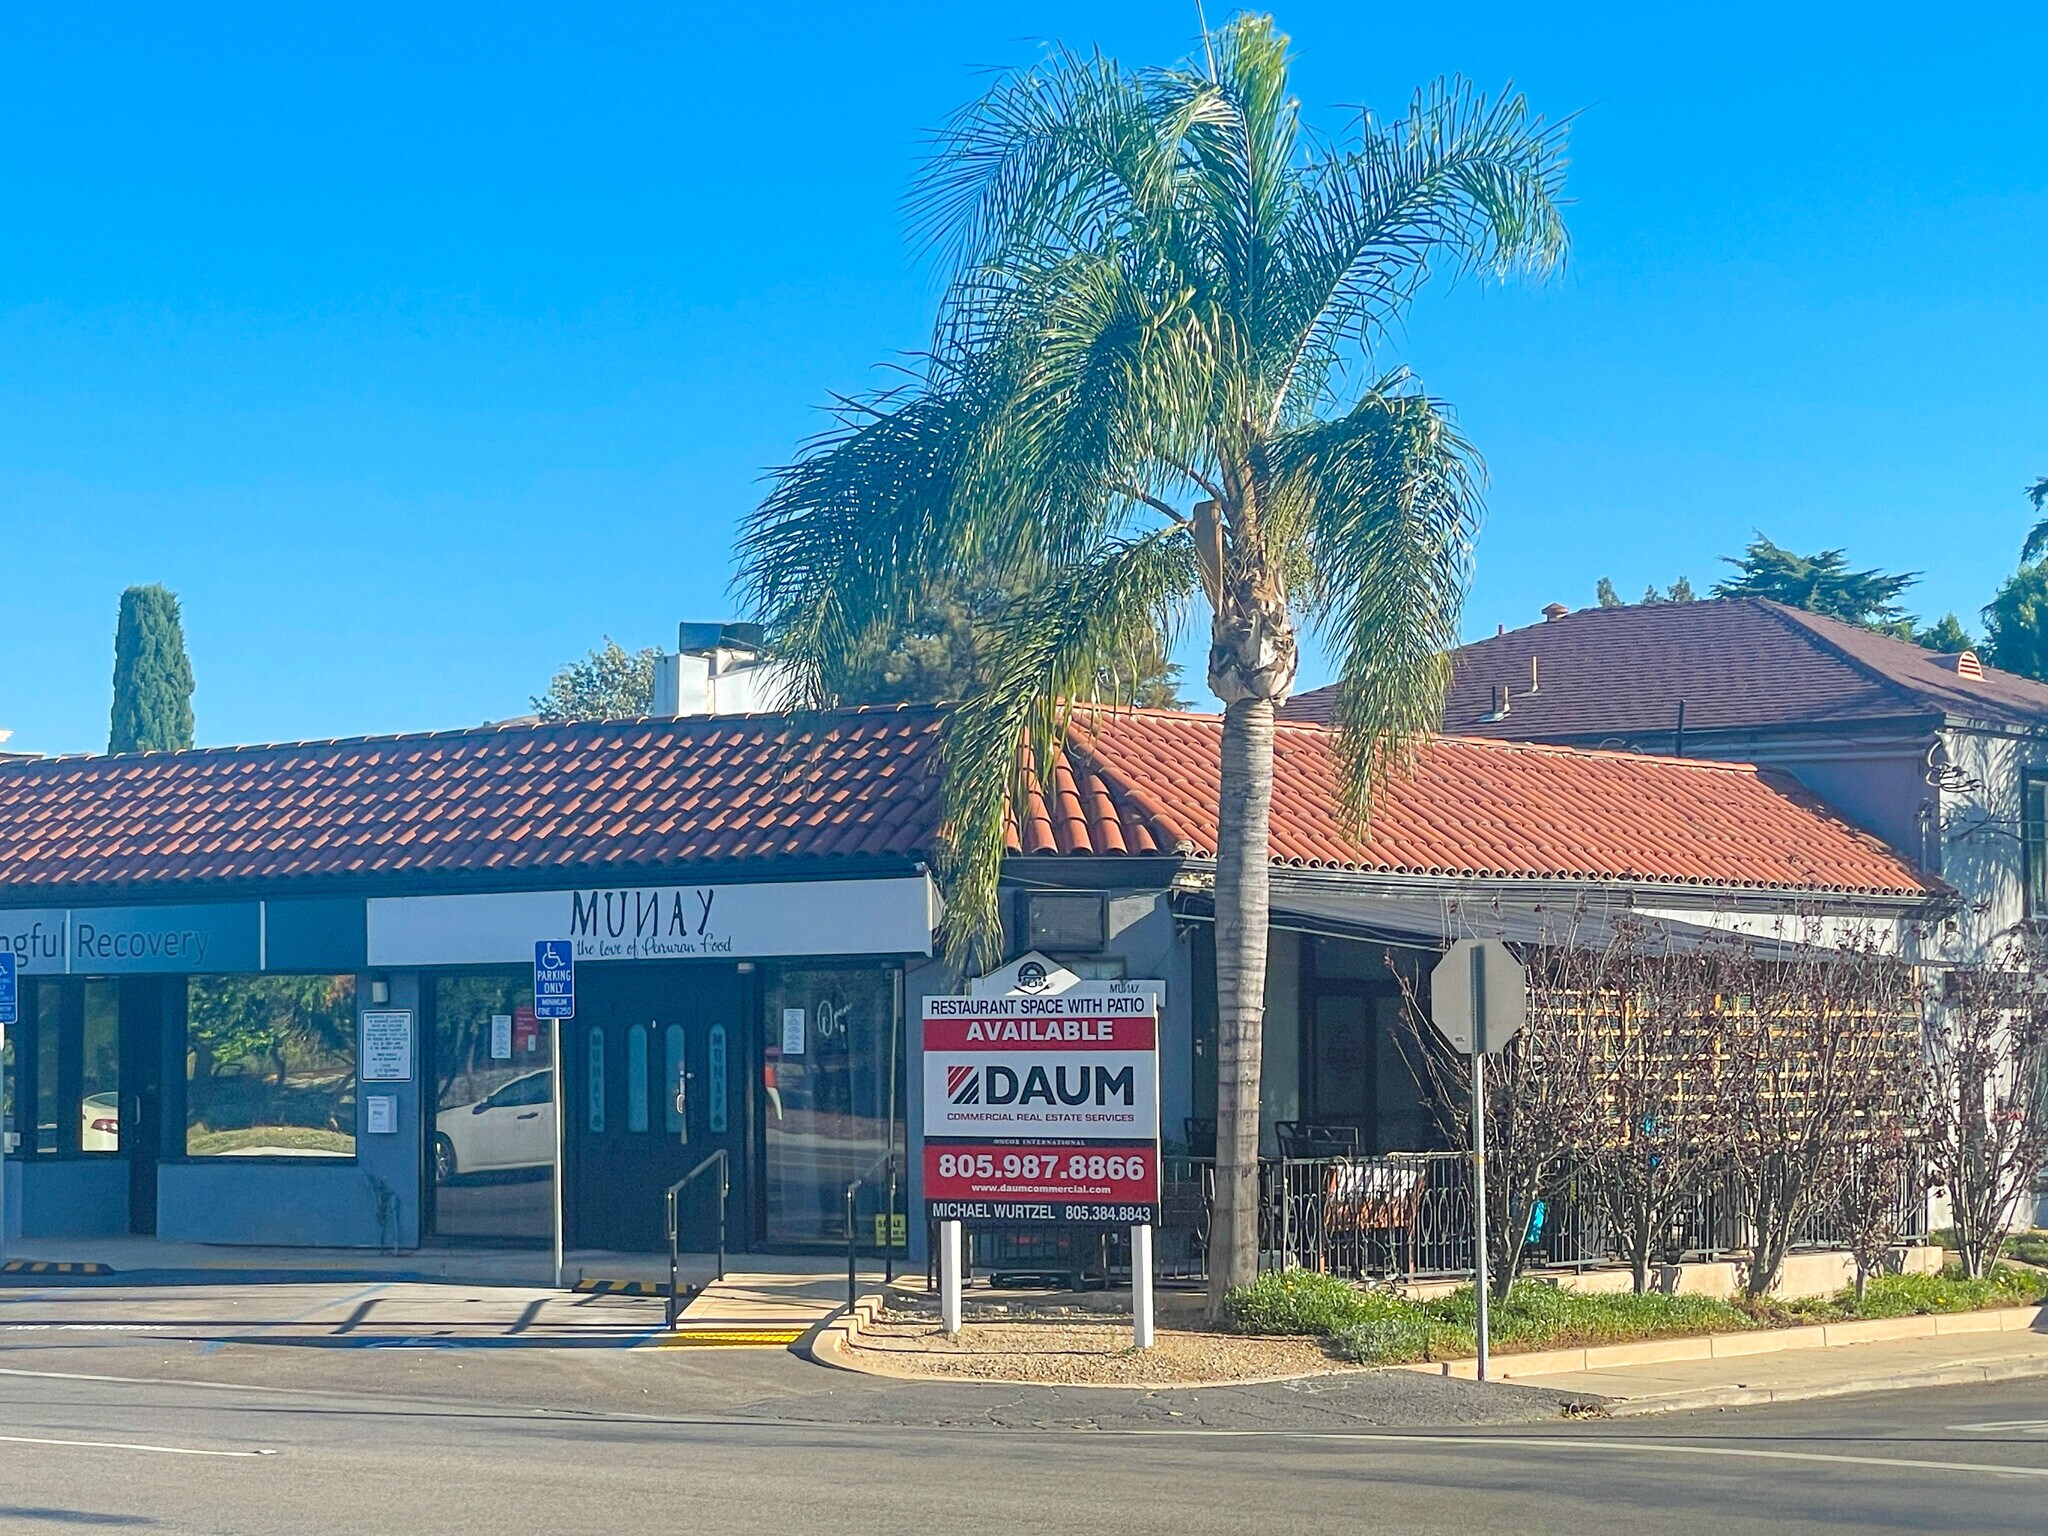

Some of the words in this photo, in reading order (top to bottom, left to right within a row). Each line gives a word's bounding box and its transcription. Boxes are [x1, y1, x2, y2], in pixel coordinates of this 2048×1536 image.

[78, 924, 210, 966] Recovery
[577, 940, 595, 956] the
[600, 940, 622, 957] love
[627, 938, 639, 958] of
[537, 969, 571, 982] PARKING
[544, 982, 564, 994] ONLY
[931, 1000, 1016, 1015] RESTAURANT
[1020, 999, 1063, 1014] SPACE
[1068, 999, 1102, 1013] WITH
[1107, 997, 1145, 1013] PATIO
[966, 1021, 1114, 1041] AVAILABLE
[986, 1066, 1134, 1106] DAUM
[947, 1112, 1014, 1121] COMMERCIAL
[1016, 1113, 1042, 1122] REAL
[1045, 1113, 1082, 1122] ESTATE
[1085, 1113, 1135, 1123] SERVICES
[939, 1154, 1145, 1181] 805.987.8866
[971, 1183, 1111, 1195] www.daumcommercial.com
[932, 1202, 991, 1218] MICHAEL
[994, 1204, 1056, 1219] WURTZEL
[1065, 1205, 1151, 1221] 805.384.8843
